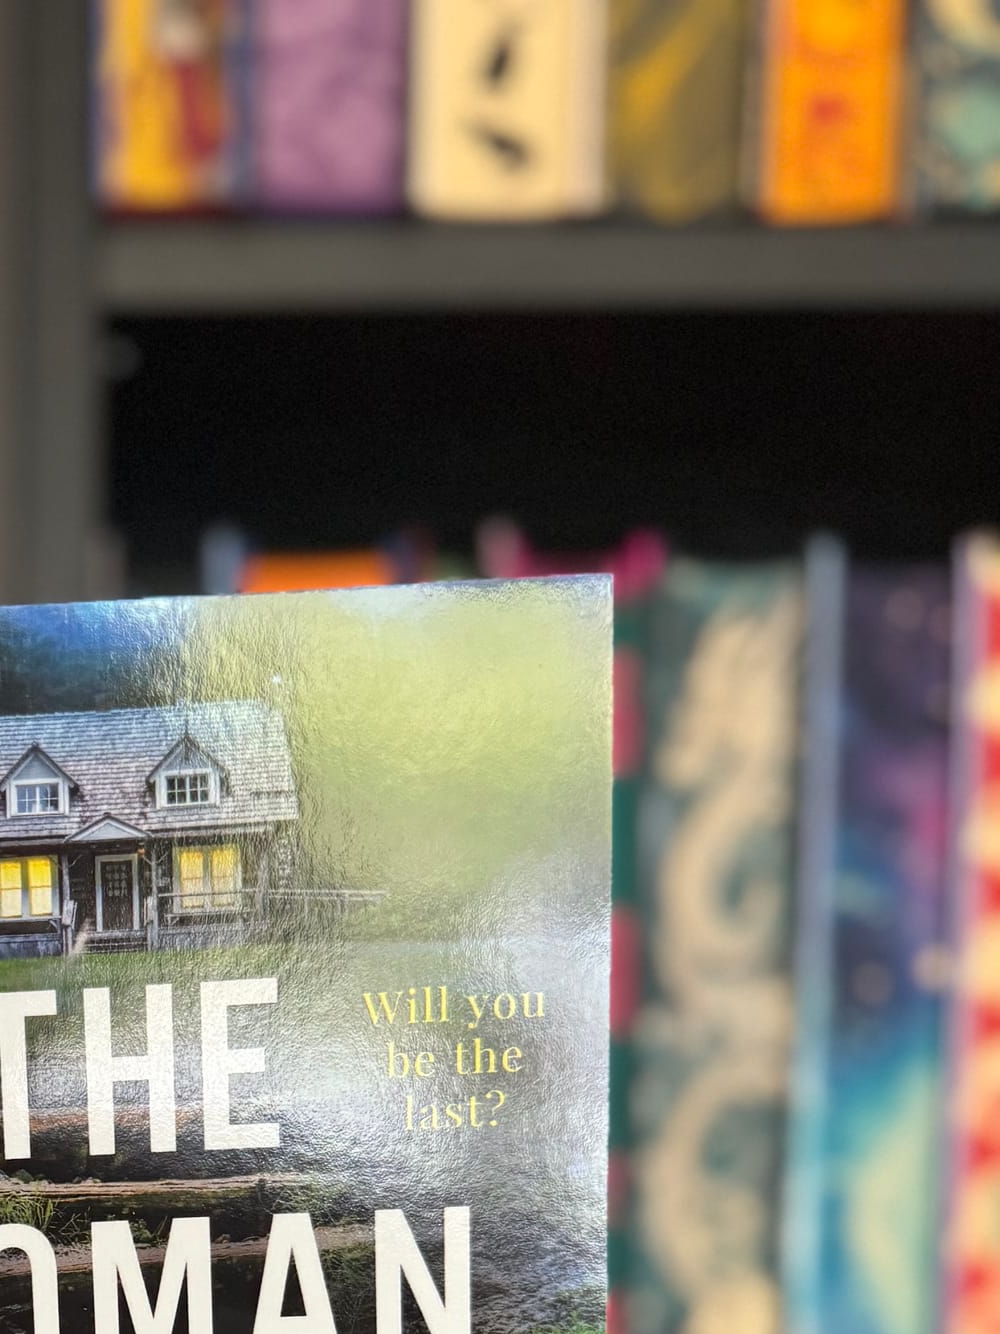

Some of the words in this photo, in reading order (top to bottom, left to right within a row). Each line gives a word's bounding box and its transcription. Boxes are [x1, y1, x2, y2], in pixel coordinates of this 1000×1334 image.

[362, 984, 451, 1026] Will
[464, 990, 546, 1030] you
[386, 1039, 436, 1080] be
[455, 1036, 524, 1076] the
[404, 1088, 507, 1131] last?
